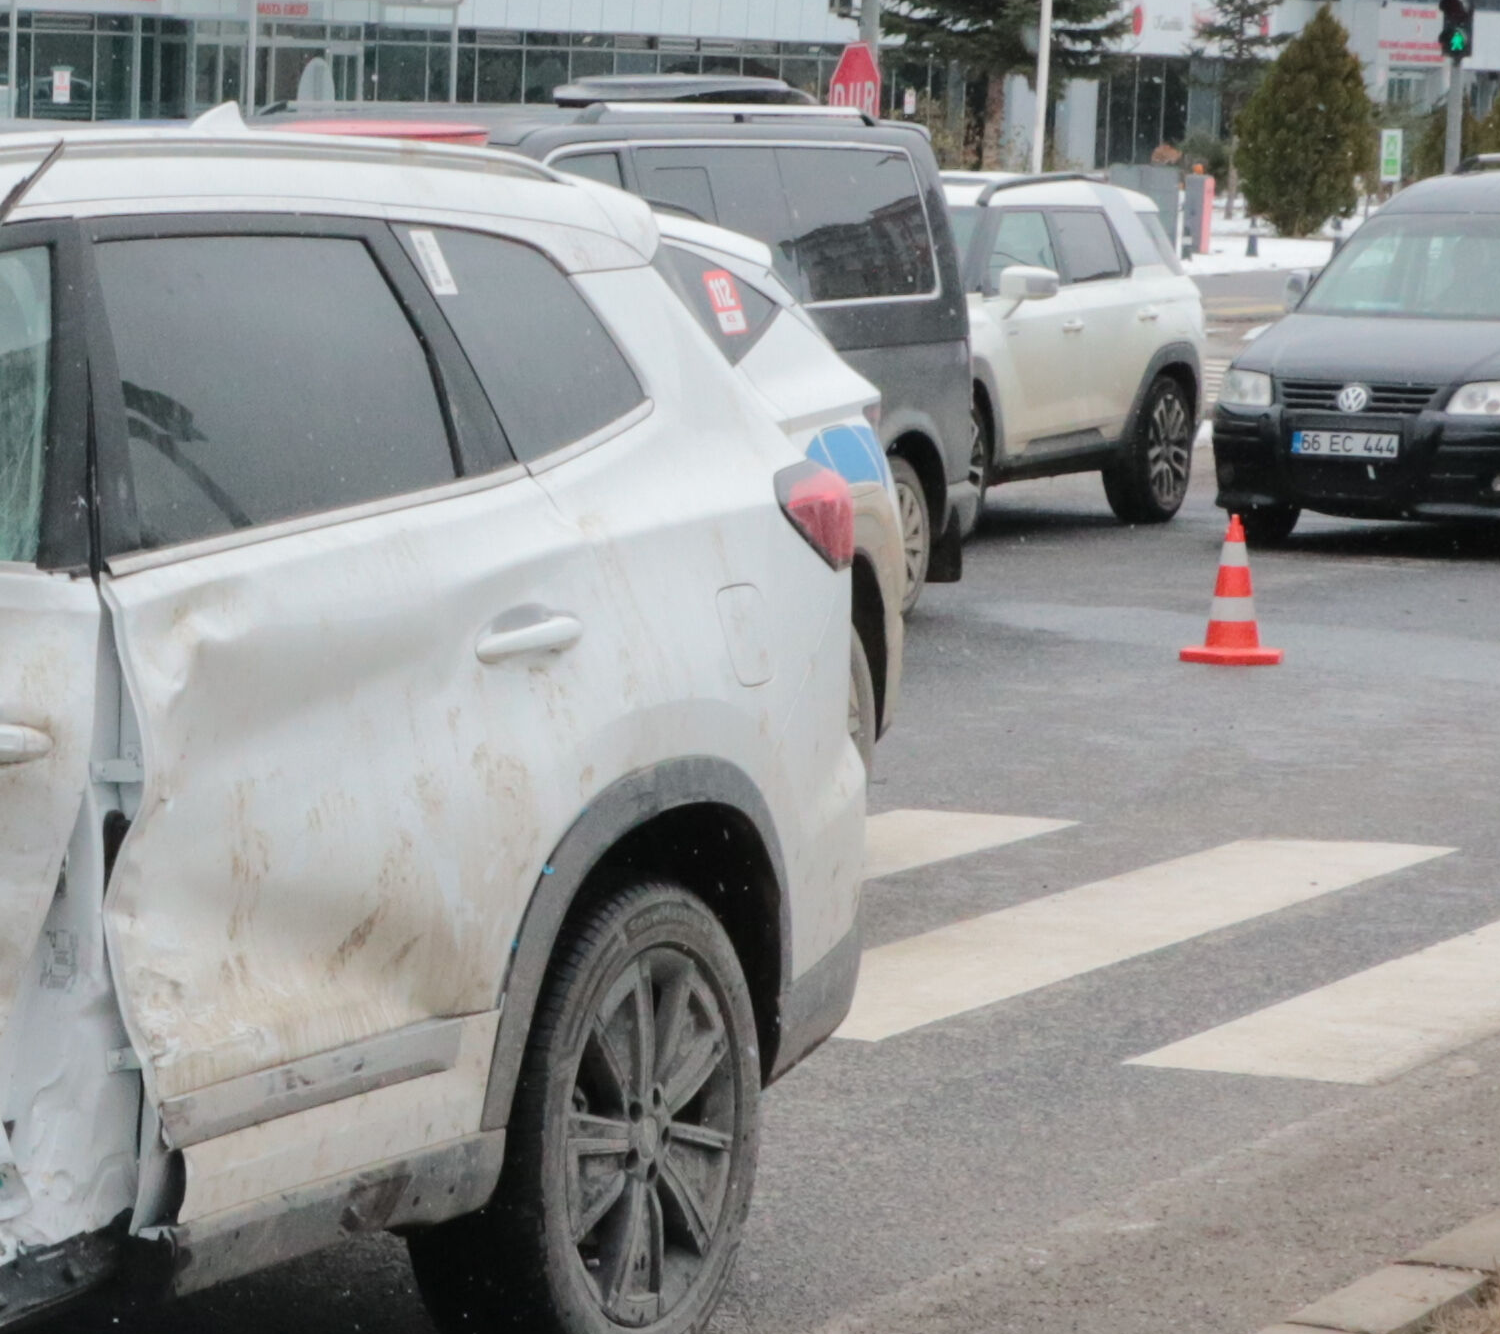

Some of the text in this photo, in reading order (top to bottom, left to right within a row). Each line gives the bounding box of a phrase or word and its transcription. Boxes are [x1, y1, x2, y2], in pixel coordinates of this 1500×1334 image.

[834, 81, 875, 116] DUR
[708, 278, 737, 308] 112
[1301, 434, 1395, 454] 66 EC 444
